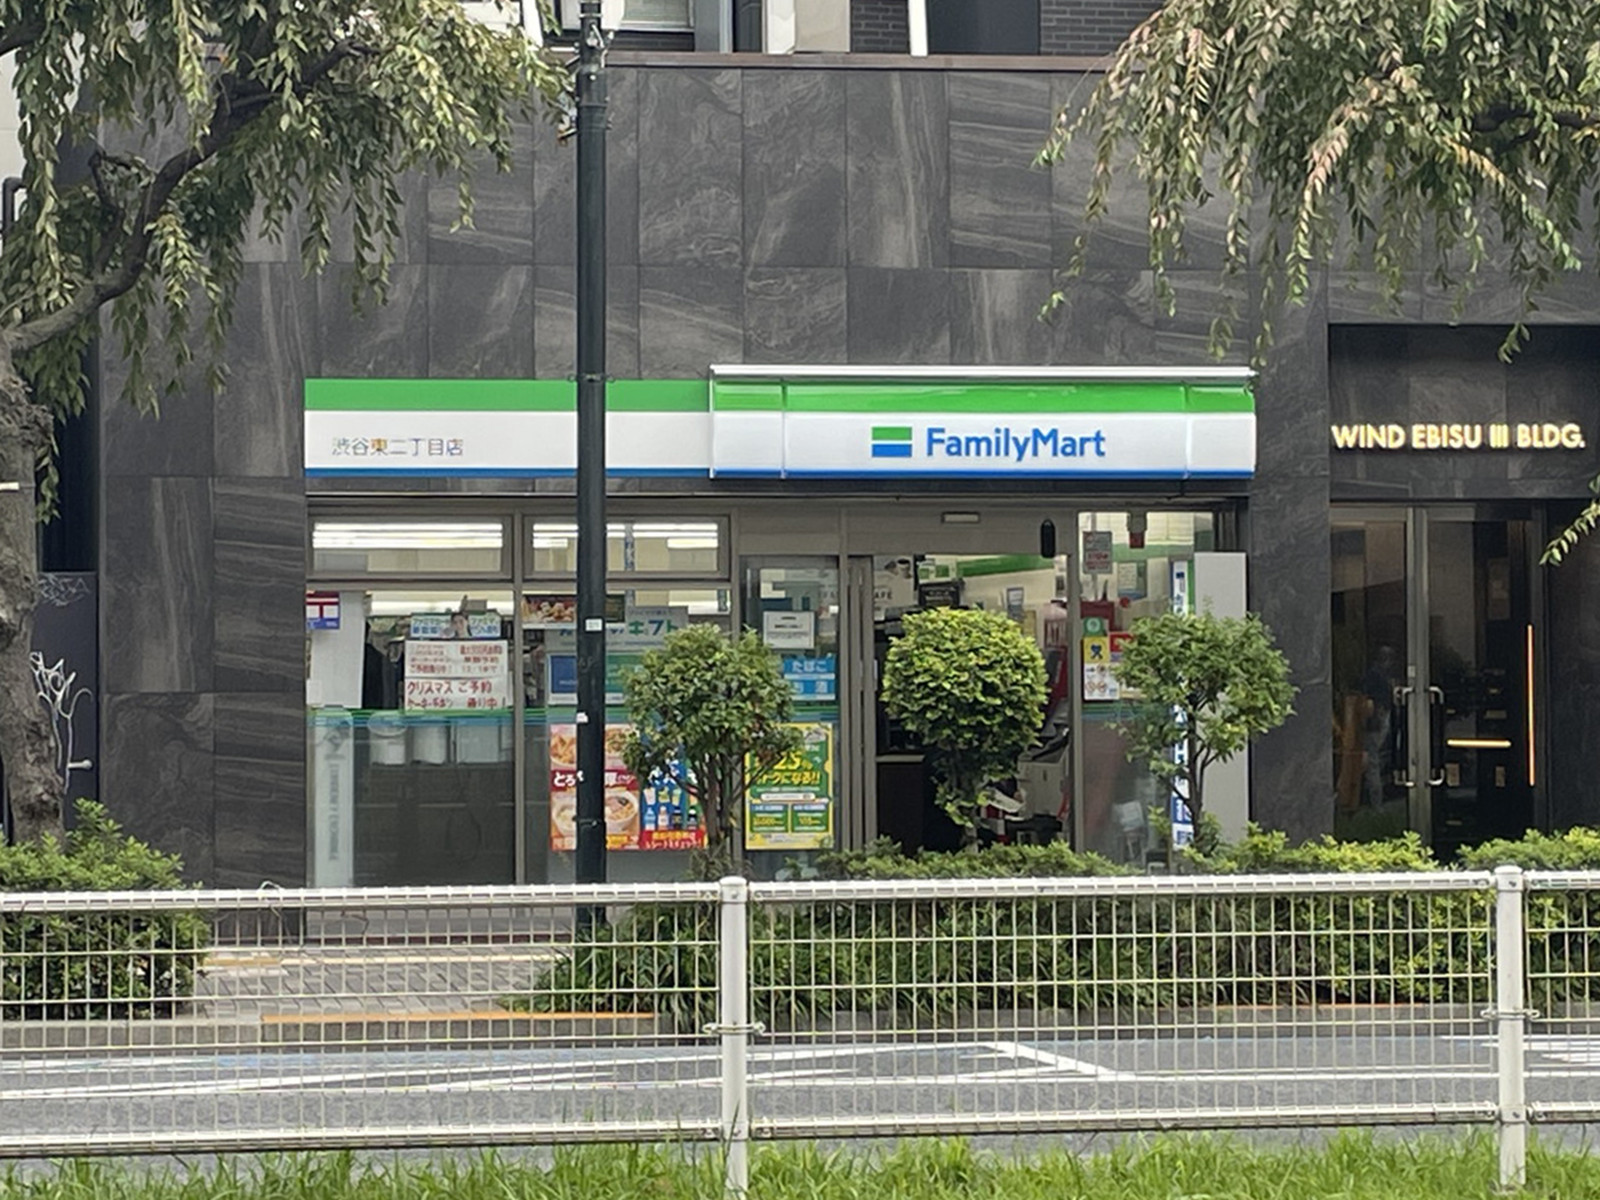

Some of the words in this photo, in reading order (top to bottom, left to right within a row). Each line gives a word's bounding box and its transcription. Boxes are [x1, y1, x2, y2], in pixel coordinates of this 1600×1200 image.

[332, 437, 464, 456] 渋谷東二丁目店
[926, 427, 1106, 462] FamilyMart
[1331, 423, 1406, 449] WIND
[1411, 423, 1483, 449] EBISU
[1516, 423, 1586, 449] BLDG.
[406, 680, 453, 696] クリスマス
[458, 680, 493, 695] ご予約
